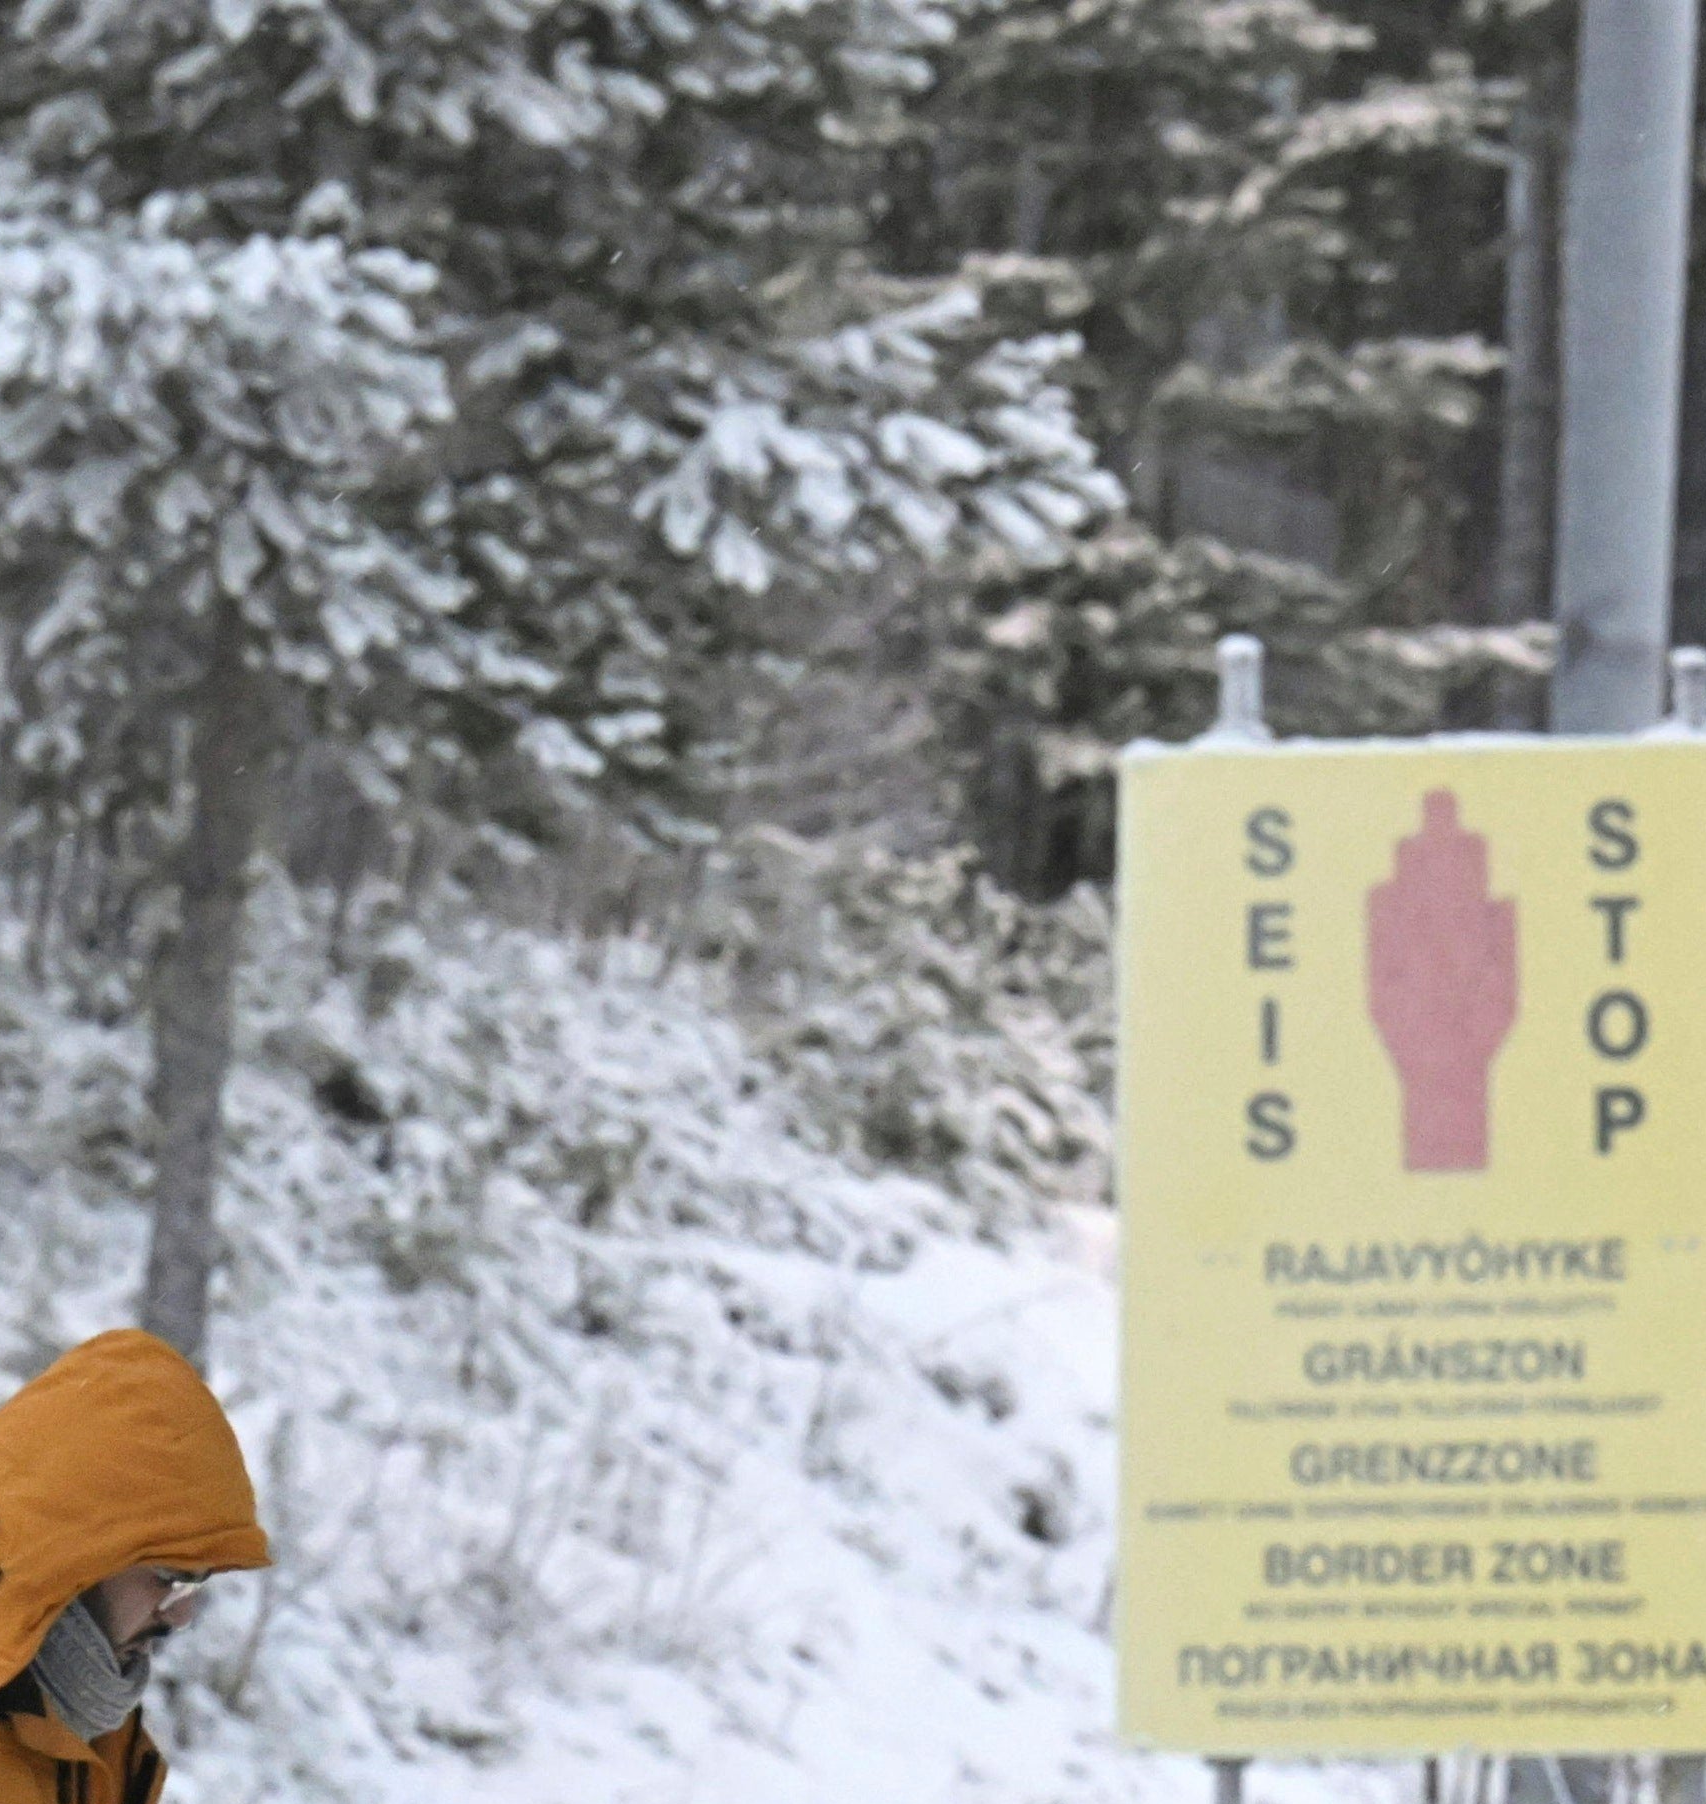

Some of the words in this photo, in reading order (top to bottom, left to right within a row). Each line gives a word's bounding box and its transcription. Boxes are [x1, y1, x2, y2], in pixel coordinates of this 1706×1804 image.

[1244, 807, 1295, 1163] SEIS
[1587, 798, 1649, 1156] STOP
[1263, 1237, 1627, 1287] RAJAVYÖHYKE
[1289, 1439, 1599, 1486] GRENZZONE
[1262, 1542, 1474, 1588] BORDER
[1488, 1539, 1627, 1585] ZONE
[1177, 1643, 1559, 1688] ПОГРАНИЧНАЯ
